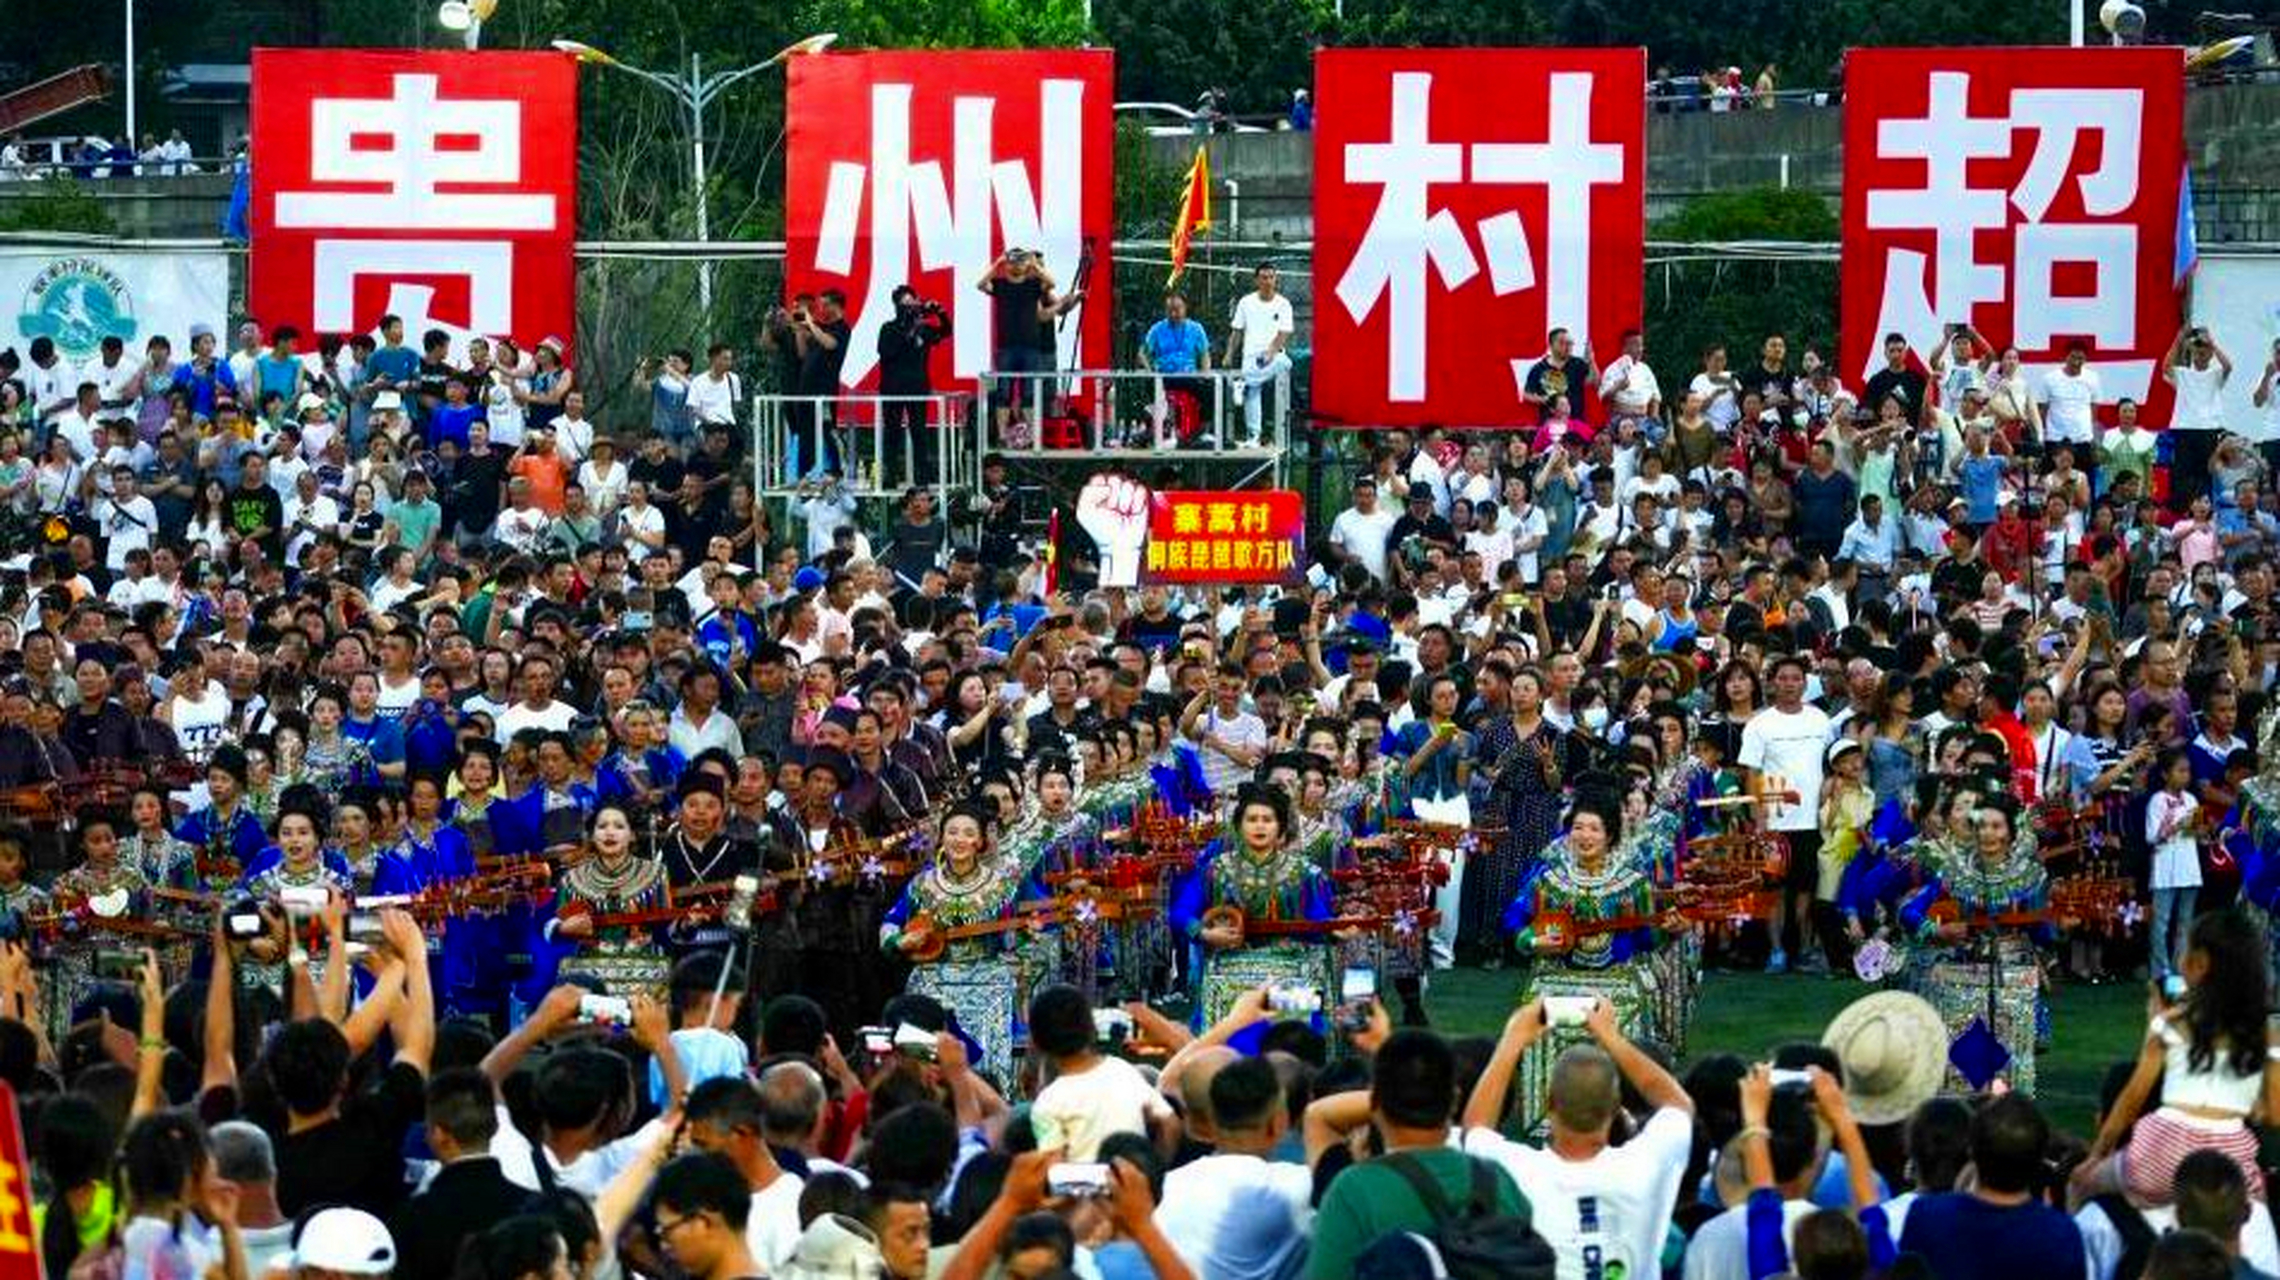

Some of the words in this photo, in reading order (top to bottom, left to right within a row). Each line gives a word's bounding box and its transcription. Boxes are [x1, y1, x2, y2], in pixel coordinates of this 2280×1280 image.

[275, 73, 557, 366] 贵
[814, 78, 1085, 396] 州
[1333, 71, 1624, 402] 村
[1861, 71, 2157, 405] 超
